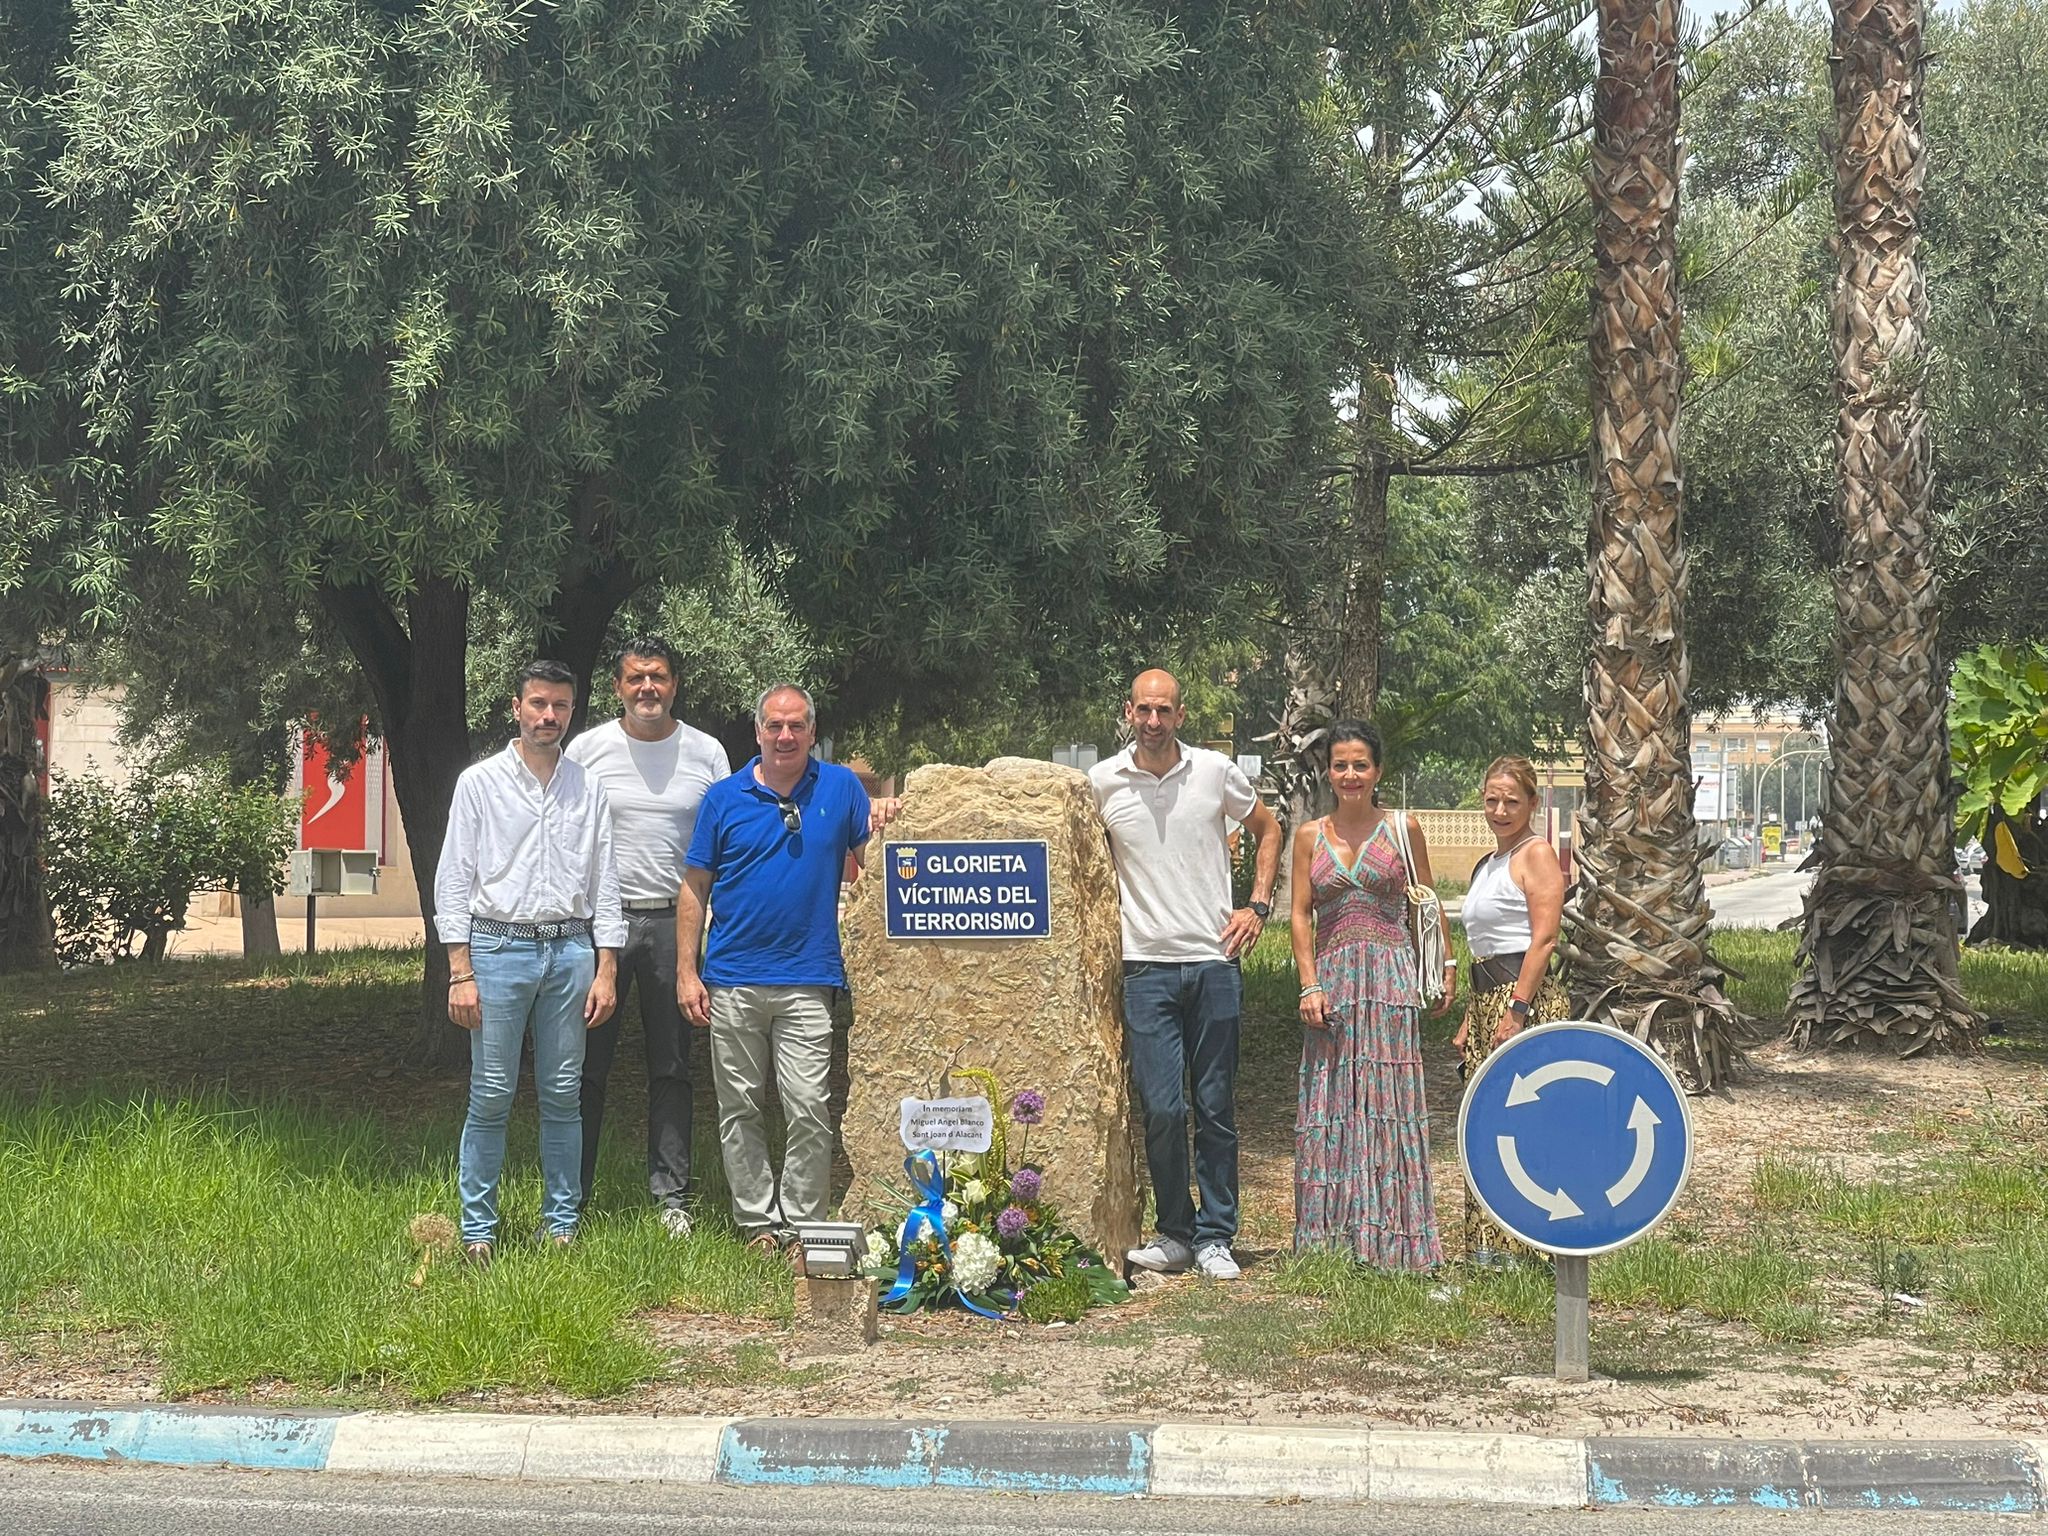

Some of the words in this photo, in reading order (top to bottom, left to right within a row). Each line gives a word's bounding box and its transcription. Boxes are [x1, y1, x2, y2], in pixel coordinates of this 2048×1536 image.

[926, 855, 1027, 873] GLORIETA
[898, 883, 992, 904] VÍCTIMAS
[997, 886, 1037, 904] DEL
[902, 912, 1035, 930] TERRORISMO
[923, 1104, 931, 1112] In
[930, 1131, 947, 1139] Joan
